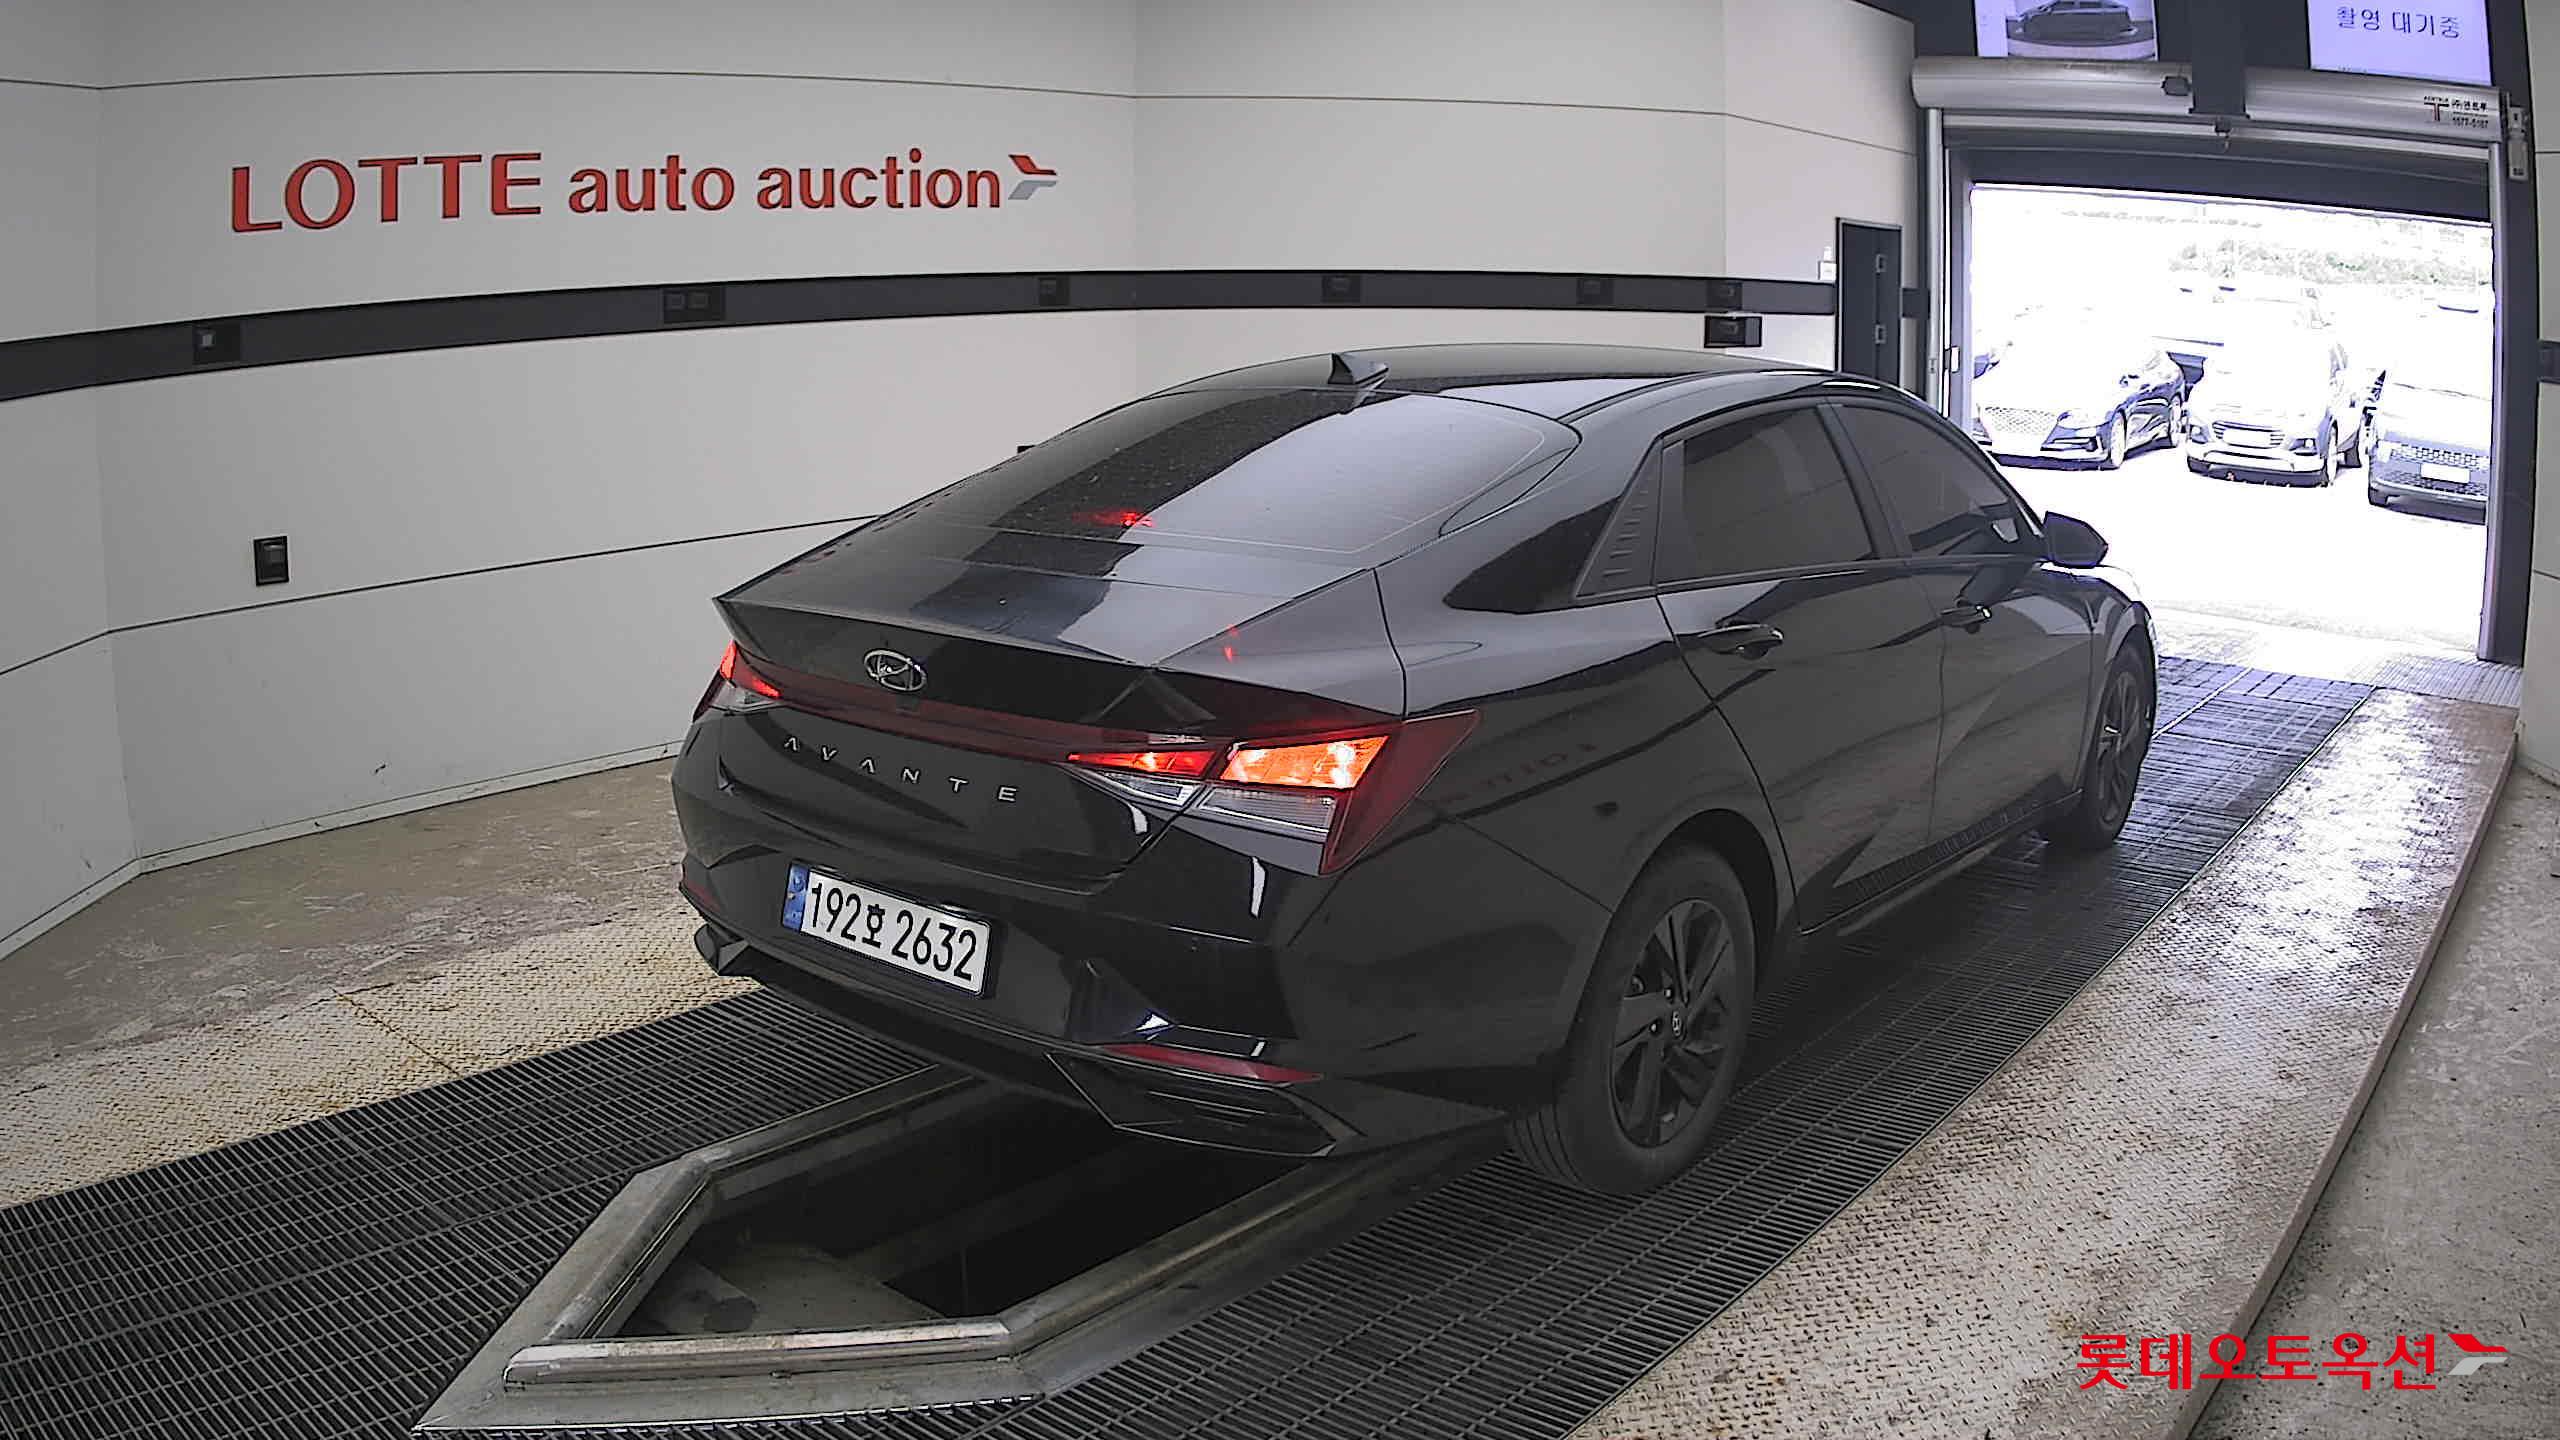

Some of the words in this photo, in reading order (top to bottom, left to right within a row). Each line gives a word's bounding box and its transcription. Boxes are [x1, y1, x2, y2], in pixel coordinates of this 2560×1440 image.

[2392, 11, 2460, 39] 대기중
[231, 151, 545, 234] LOTTE
[567, 153, 737, 217] auto
[754, 147, 1003, 212] auction
[783, 735, 1019, 803] AVANTE
[810, 881, 886, 950] 192호
[890, 908, 978, 983] 2632
